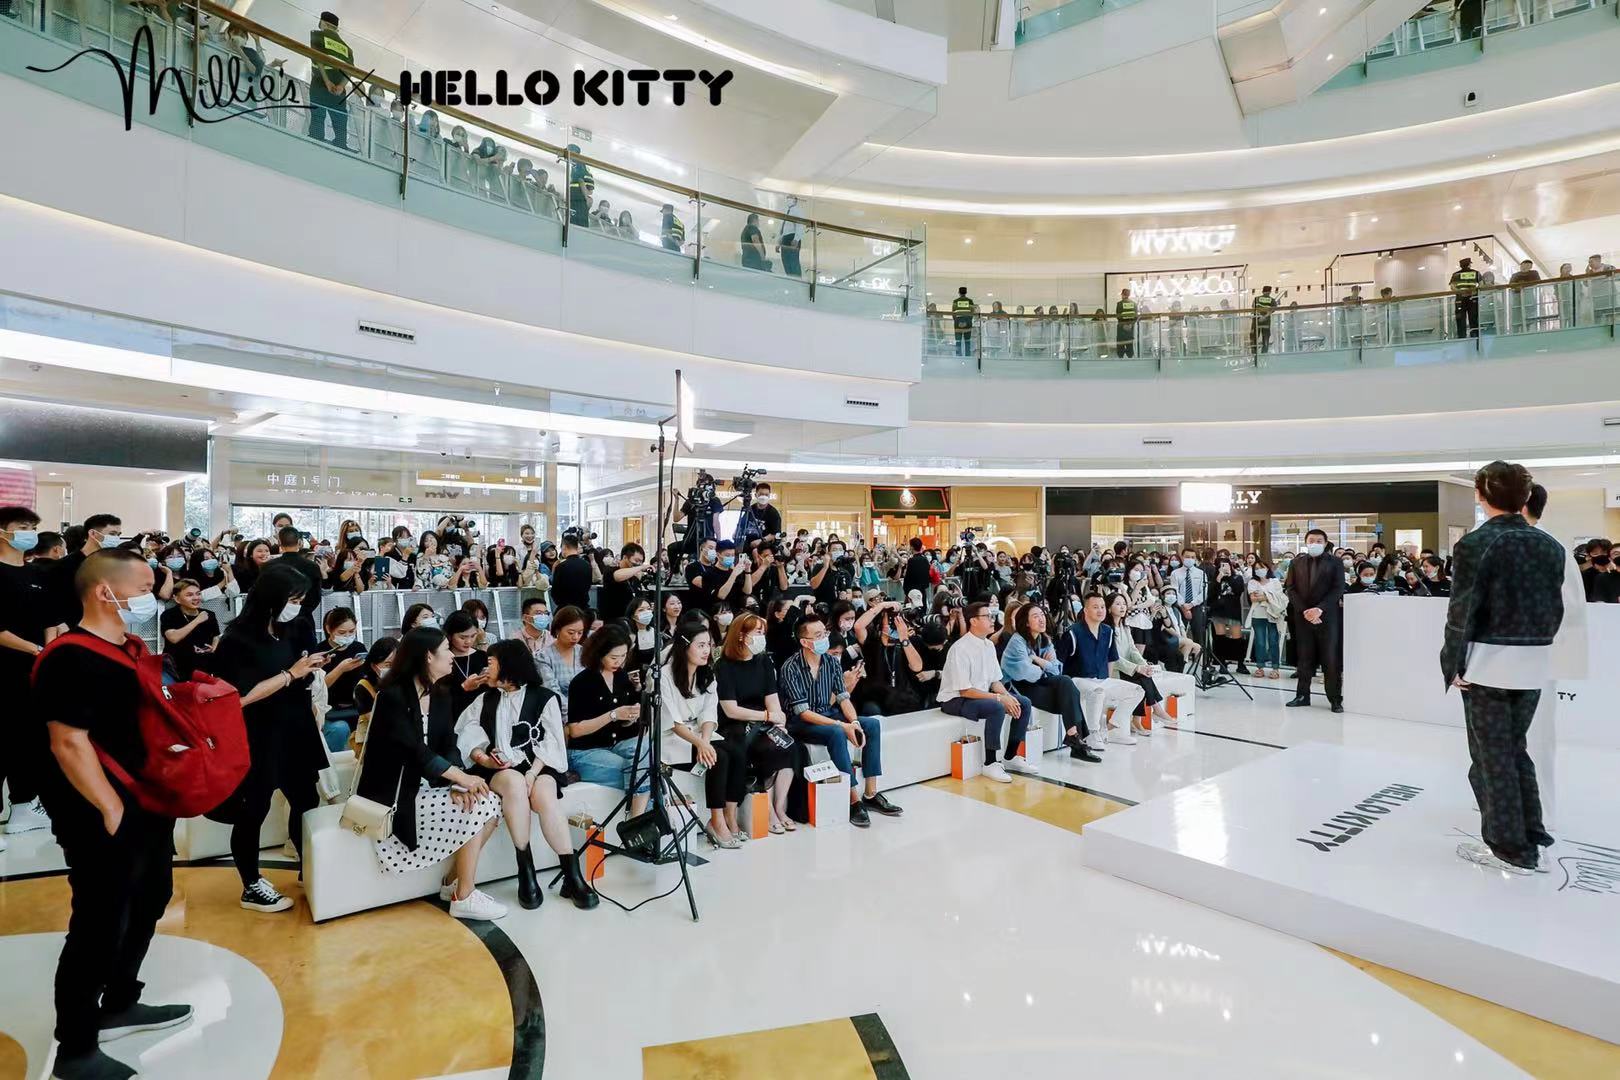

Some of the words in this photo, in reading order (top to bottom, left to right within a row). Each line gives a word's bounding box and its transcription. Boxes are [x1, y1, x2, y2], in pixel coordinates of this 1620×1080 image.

[1231, 490, 1262, 504] LY
[1557, 691, 1577, 701] TY
[1354, 783, 1425, 814] HELLO
[1296, 811, 1380, 852] KITTY
